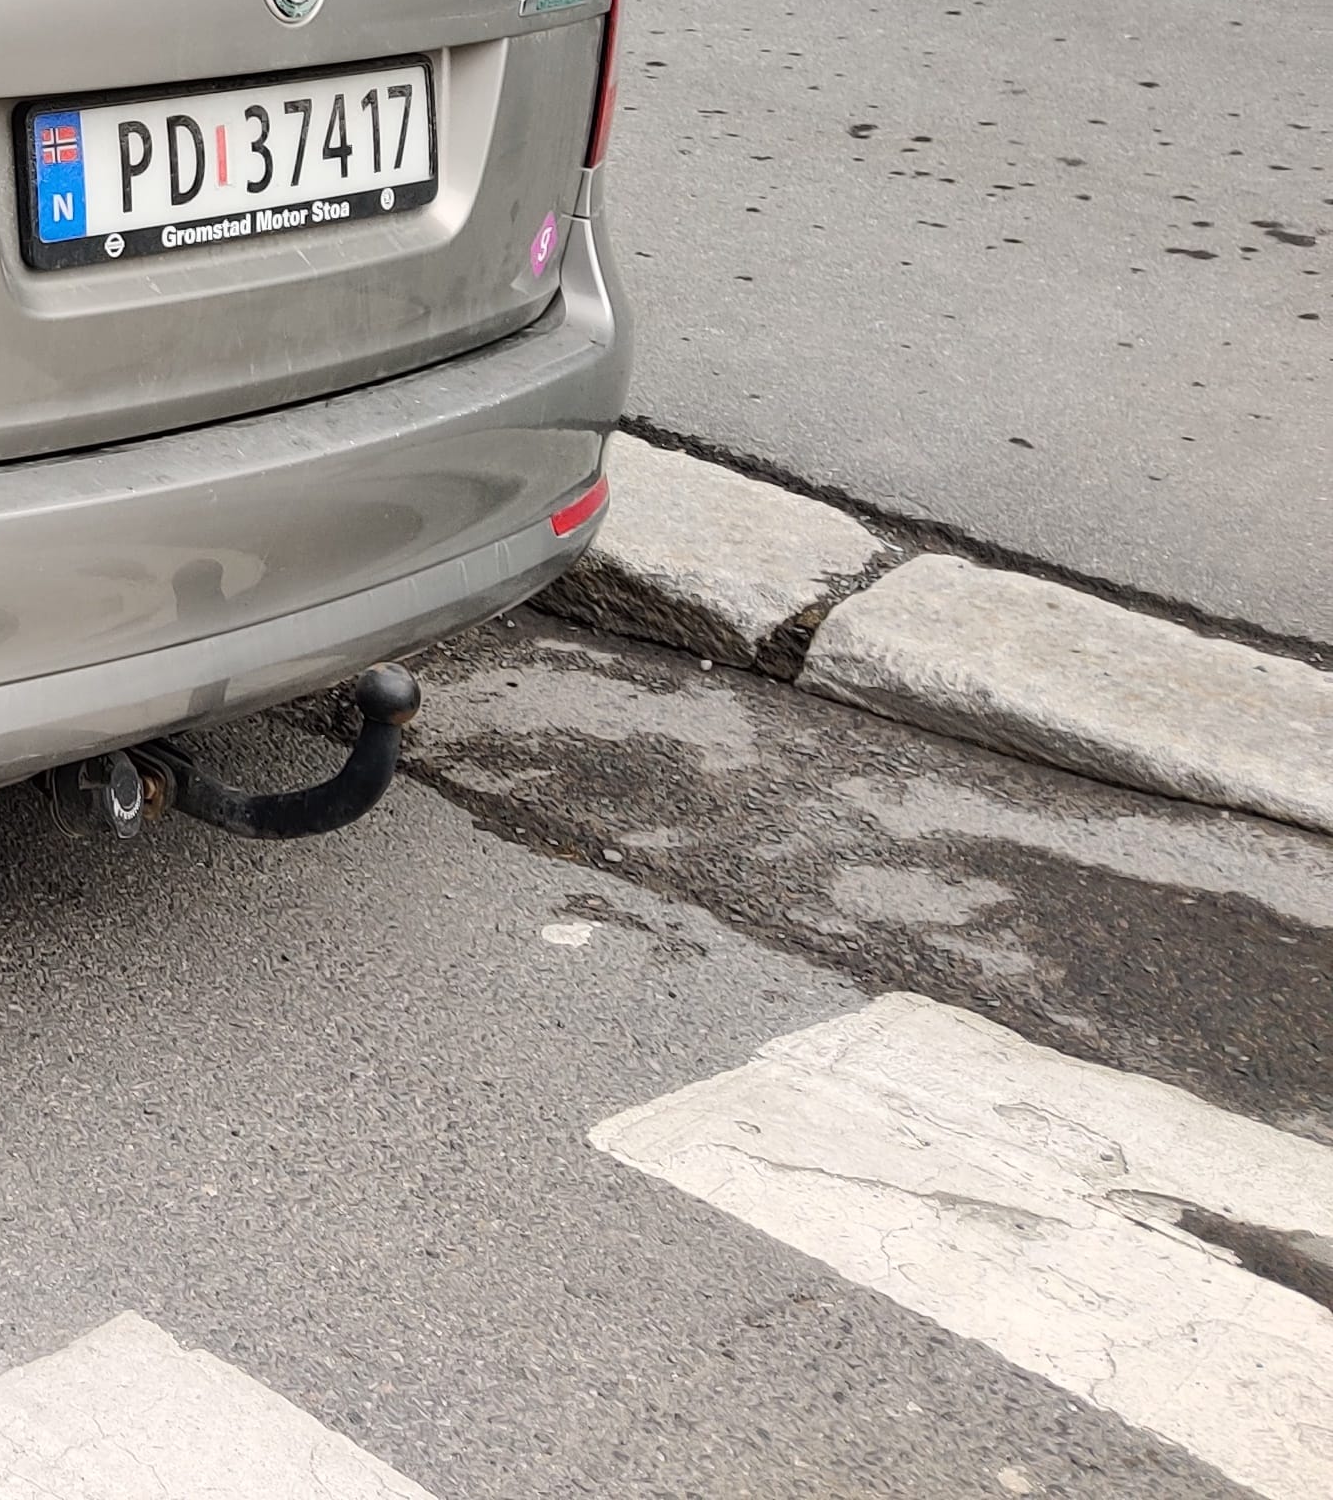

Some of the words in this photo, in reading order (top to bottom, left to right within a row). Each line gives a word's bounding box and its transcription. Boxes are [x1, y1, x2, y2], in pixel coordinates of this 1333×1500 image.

[117, 113, 207, 213] PD
[244, 83, 415, 195] 37417
[53, 193, 74, 222] N
[161, 216, 252, 248] Gromstad
[256, 205, 309, 231] Motor
[312, 200, 350, 222] Stoa
